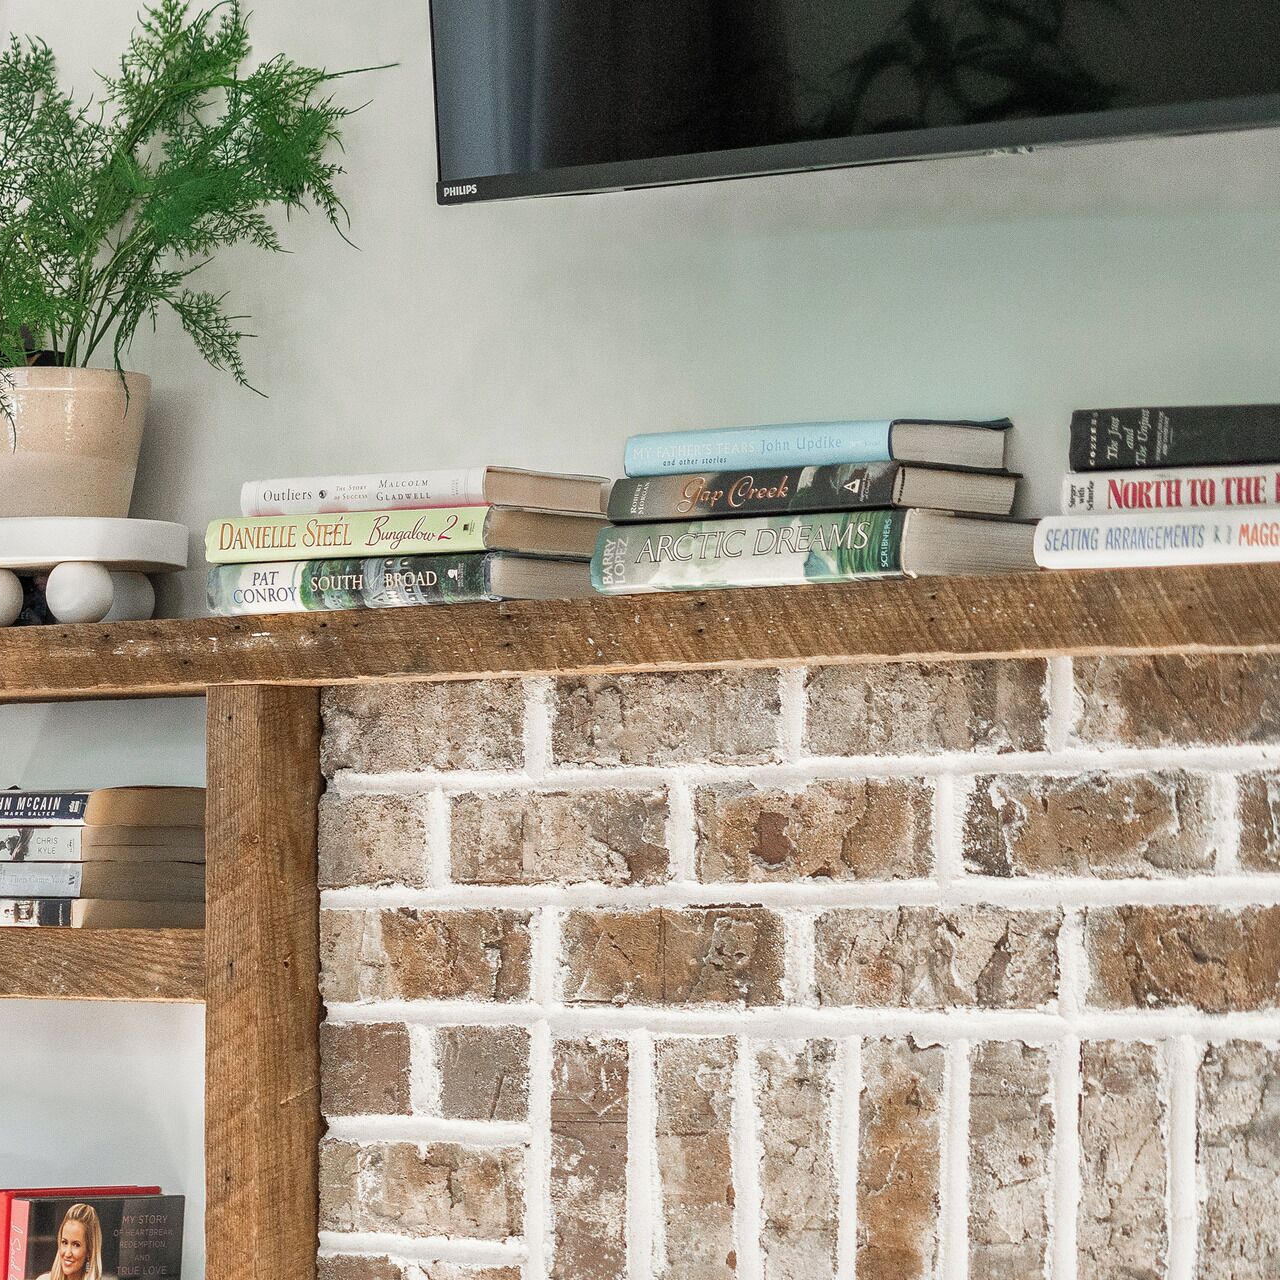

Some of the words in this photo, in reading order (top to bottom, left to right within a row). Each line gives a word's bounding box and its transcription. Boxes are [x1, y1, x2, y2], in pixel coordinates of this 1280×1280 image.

[443, 184, 477, 197] PHILIPS
[761, 438, 790, 454] John
[796, 436, 842, 454] Updike
[663, 458, 676, 467] and
[678, 458, 698, 466] other
[701, 456, 728, 465] stories
[262, 488, 313, 503] Outliers
[1187, 478, 1216, 507] TO
[1222, 476, 1267, 505] THE
[635, 529, 744, 564] ARCTIC
[752, 521, 871, 556] DREAMS
[880, 518, 892, 568] SCRIBNERS
[1044, 527, 1100, 552] SEATING
[1104, 525, 1206, 551] ARRANGEMENTS
[602, 538, 616, 586] BARRY
[614, 536, 628, 584] LOPEZ
[252, 571, 279, 586] PAT
[311, 574, 364, 592] SOUTH
[385, 570, 438, 588] BROAD
[233, 587, 297, 604] CONROY
[121, 1215, 135, 1225] MY
[137, 1215, 168, 1224] STORY
[116, 1266, 140, 1275] TRUE
[142, 1265, 168, 1276] LOVE
